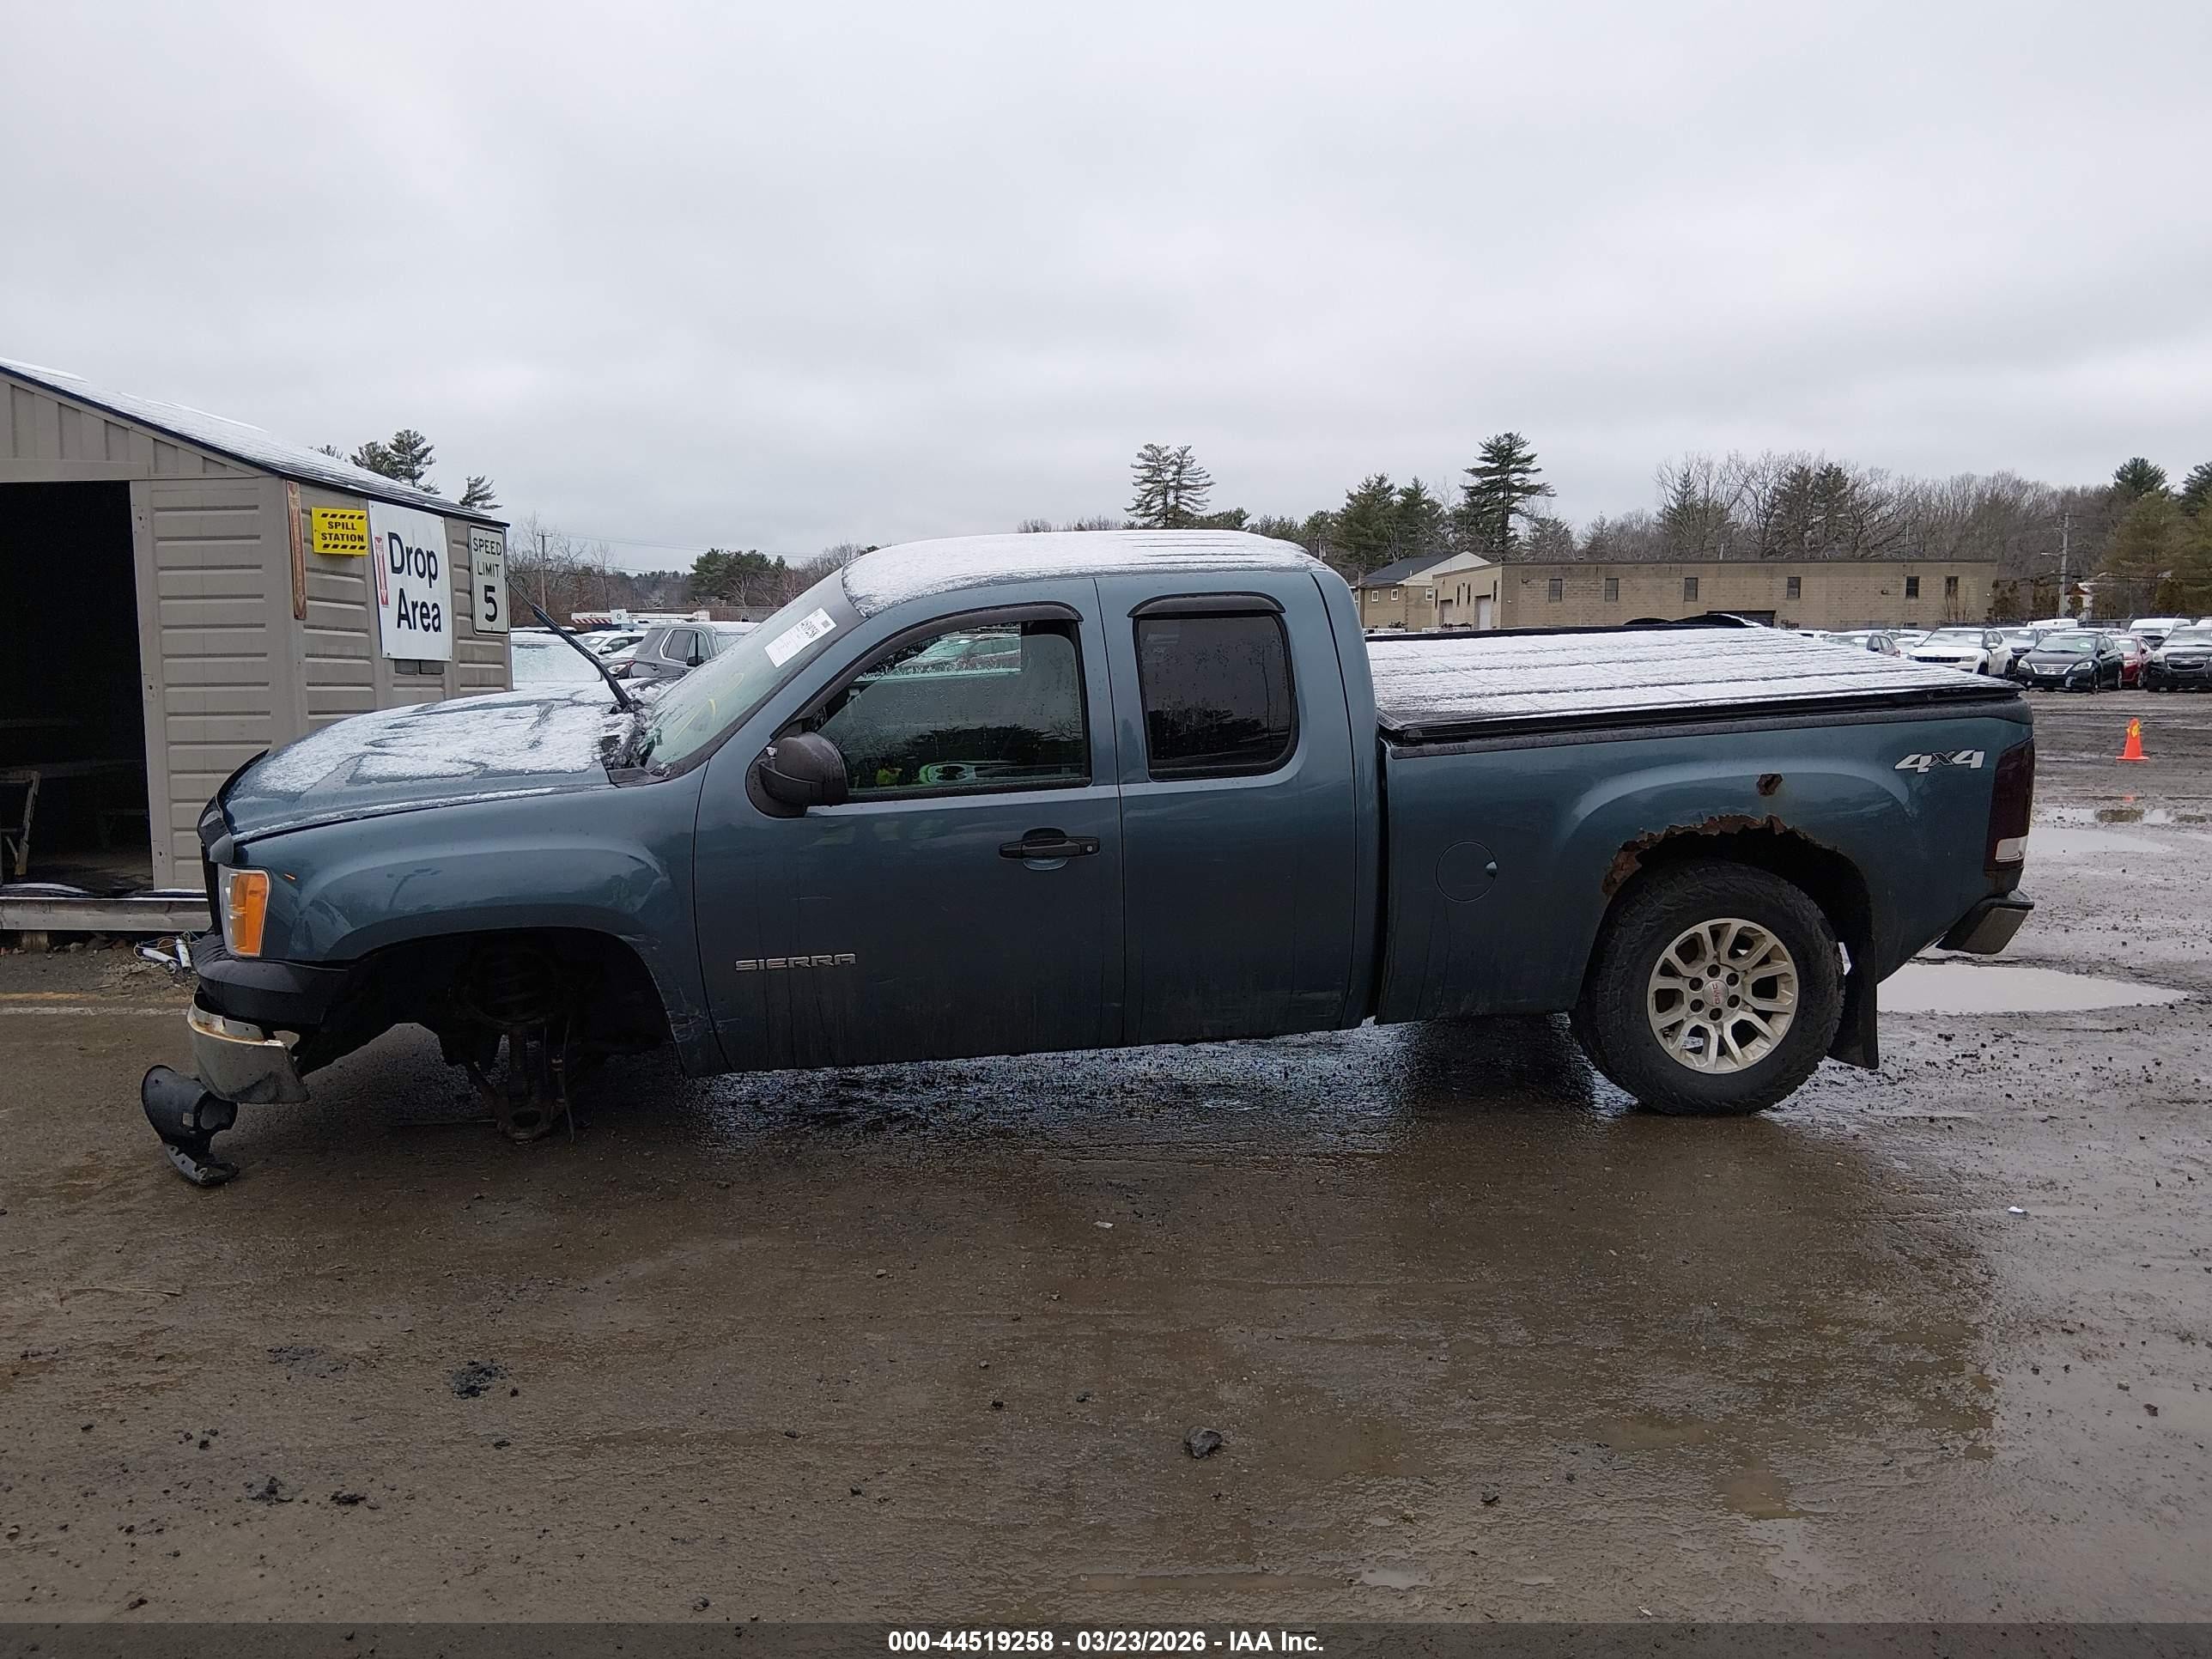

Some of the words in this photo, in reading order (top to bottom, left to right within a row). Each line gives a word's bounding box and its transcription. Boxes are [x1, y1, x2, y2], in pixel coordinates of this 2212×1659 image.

[327, 521, 357, 531] SPILL
[321, 532, 364, 542] STATION
[473, 538, 502, 556] SPEED
[388, 532, 439, 588] Drop
[477, 561, 500, 578] LIMIT
[397, 587, 442, 633] Area
[483, 585, 498, 623] 5
[735, 953, 857, 971] SIERRA
[1711, 982, 1721, 1004] GMC
